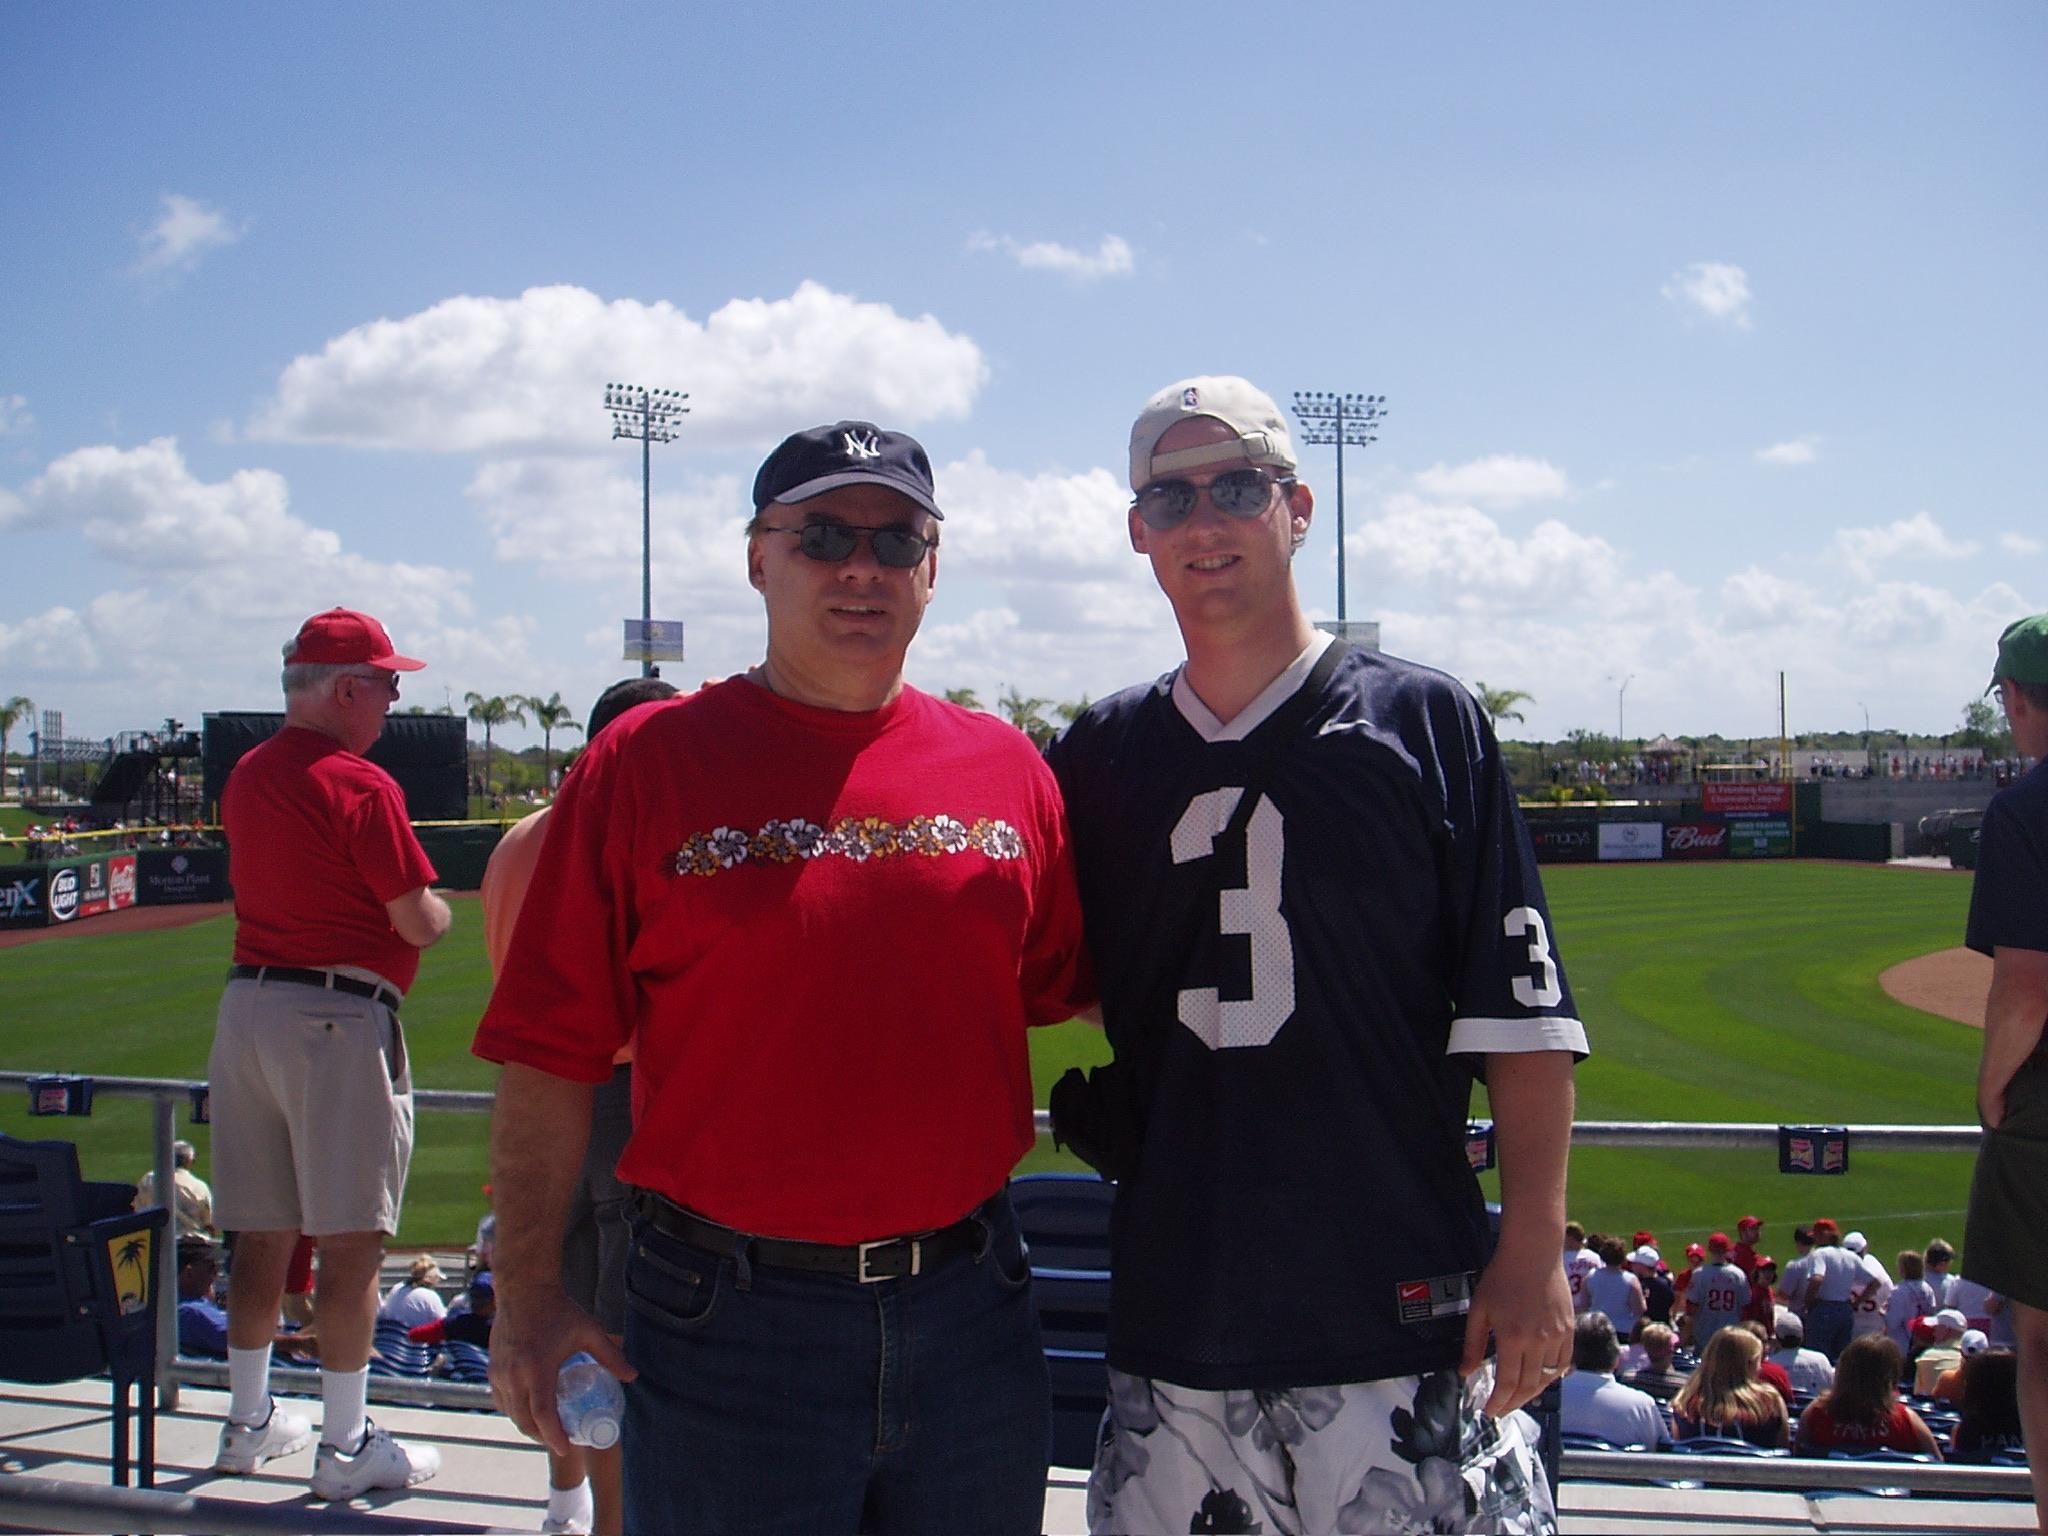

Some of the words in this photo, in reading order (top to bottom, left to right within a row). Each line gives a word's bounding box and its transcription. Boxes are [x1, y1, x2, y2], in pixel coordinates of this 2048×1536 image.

[1666, 826, 1726, 849] Bud
[57, 876, 76, 892] BUD
[54, 891, 78, 909] LIGHT
[1170, 786, 1296, 1050] 3
[1503, 906, 1562, 1008] 3
[1708, 1289, 1736, 1312] 29
